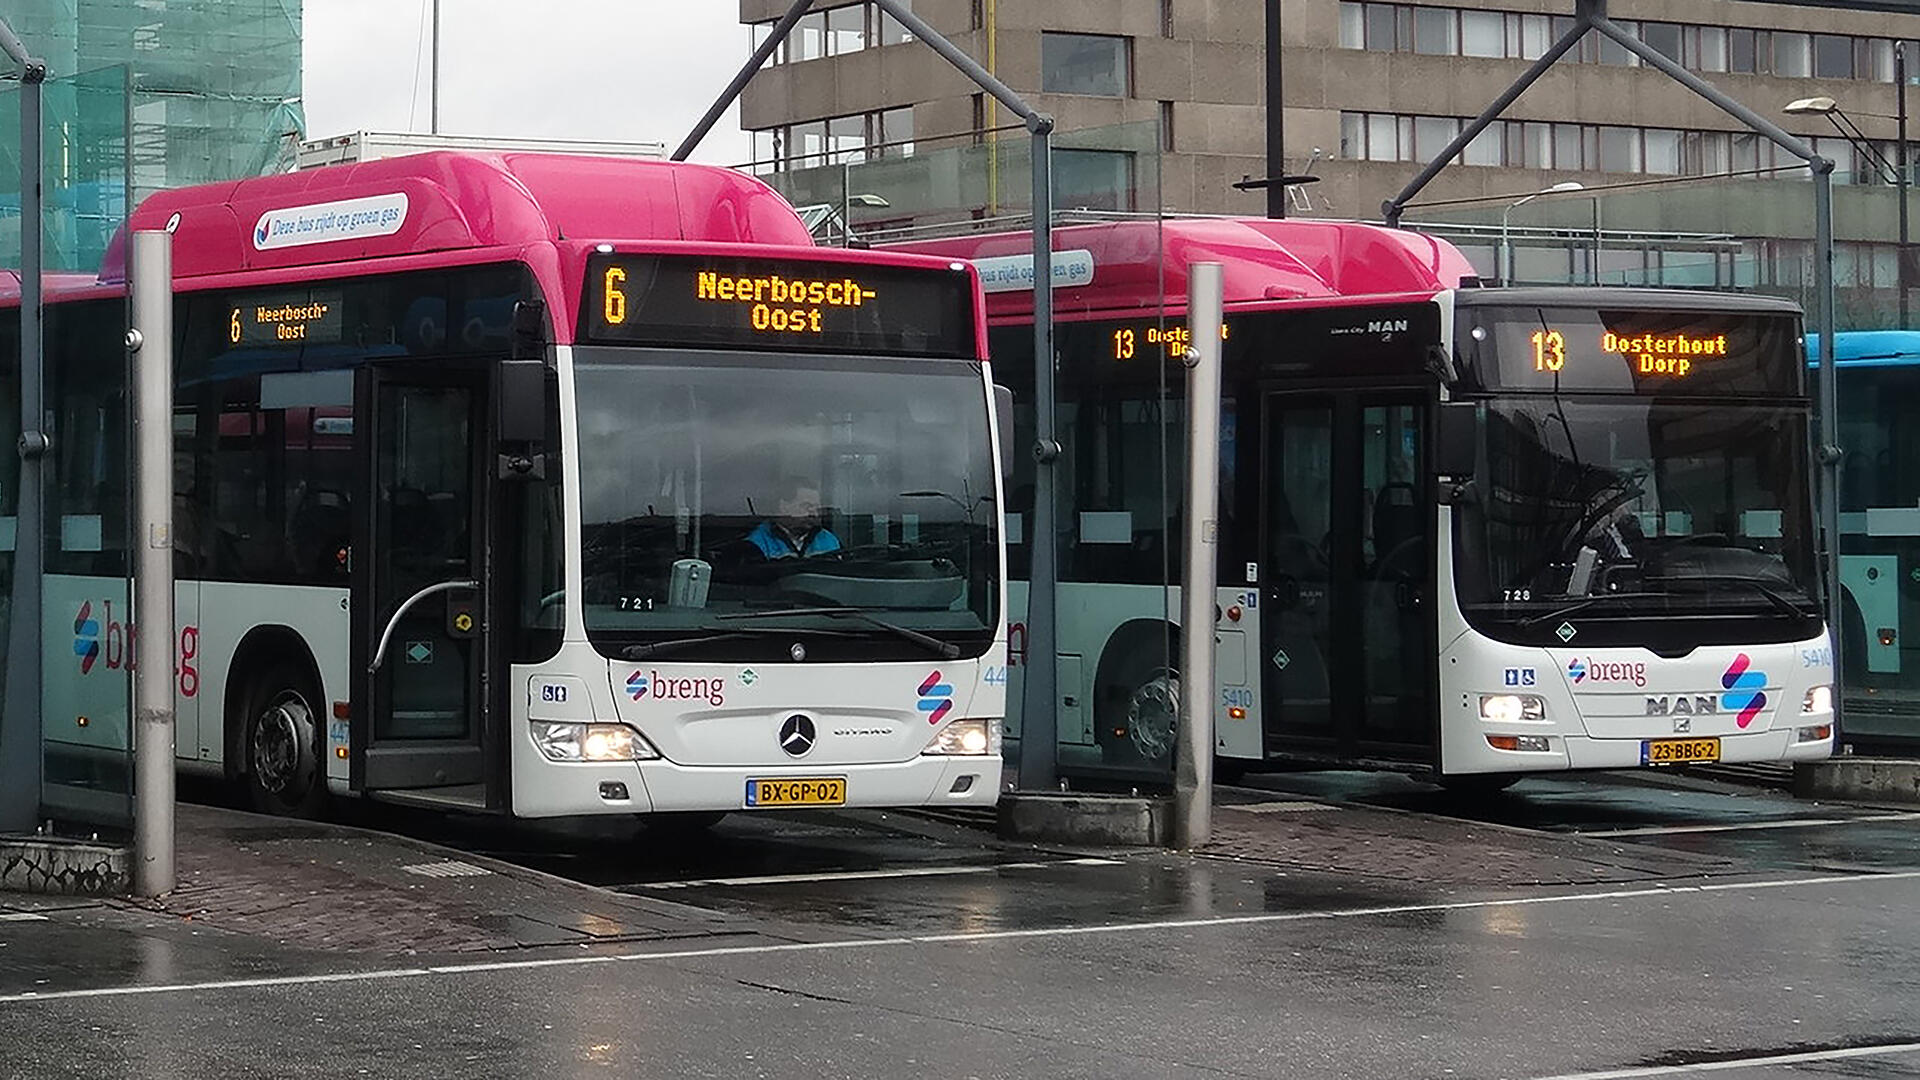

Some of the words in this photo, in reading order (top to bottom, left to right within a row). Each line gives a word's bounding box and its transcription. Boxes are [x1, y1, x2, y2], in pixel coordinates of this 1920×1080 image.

[297, 216, 314, 233] bus
[314, 212, 336, 233] rijdt
[336, 213, 350, 231] op
[349, 209, 379, 231] groen
[379, 208, 399, 227] gas
[1069, 263, 1087, 280] gas
[604, 266, 627, 325] 6
[697, 271, 877, 306] Neerbosch-
[230, 308, 241, 343] 6
[256, 302, 328, 323] Neerbosch-
[751, 303, 823, 333] Oost
[1367, 319, 1408, 333] MAN
[277, 323, 306, 340] Oost
[1113, 328, 1135, 360] 13
[1531, 330, 1566, 372] 13
[1602, 332, 1727, 355] Oosterhout
[1639, 353, 1692, 376] Dorp
[620, 597, 653, 610] 721
[1503, 589, 1531, 601] 728
[1586, 655, 1647, 688] breng
[650, 670, 725, 707] breng
[1221, 688, 1254, 708] 5410
[1645, 695, 1718, 717] MAN
[1653, 742, 1715, 760] 23-BBG-2
[761, 783, 839, 801] BX-GP-02
